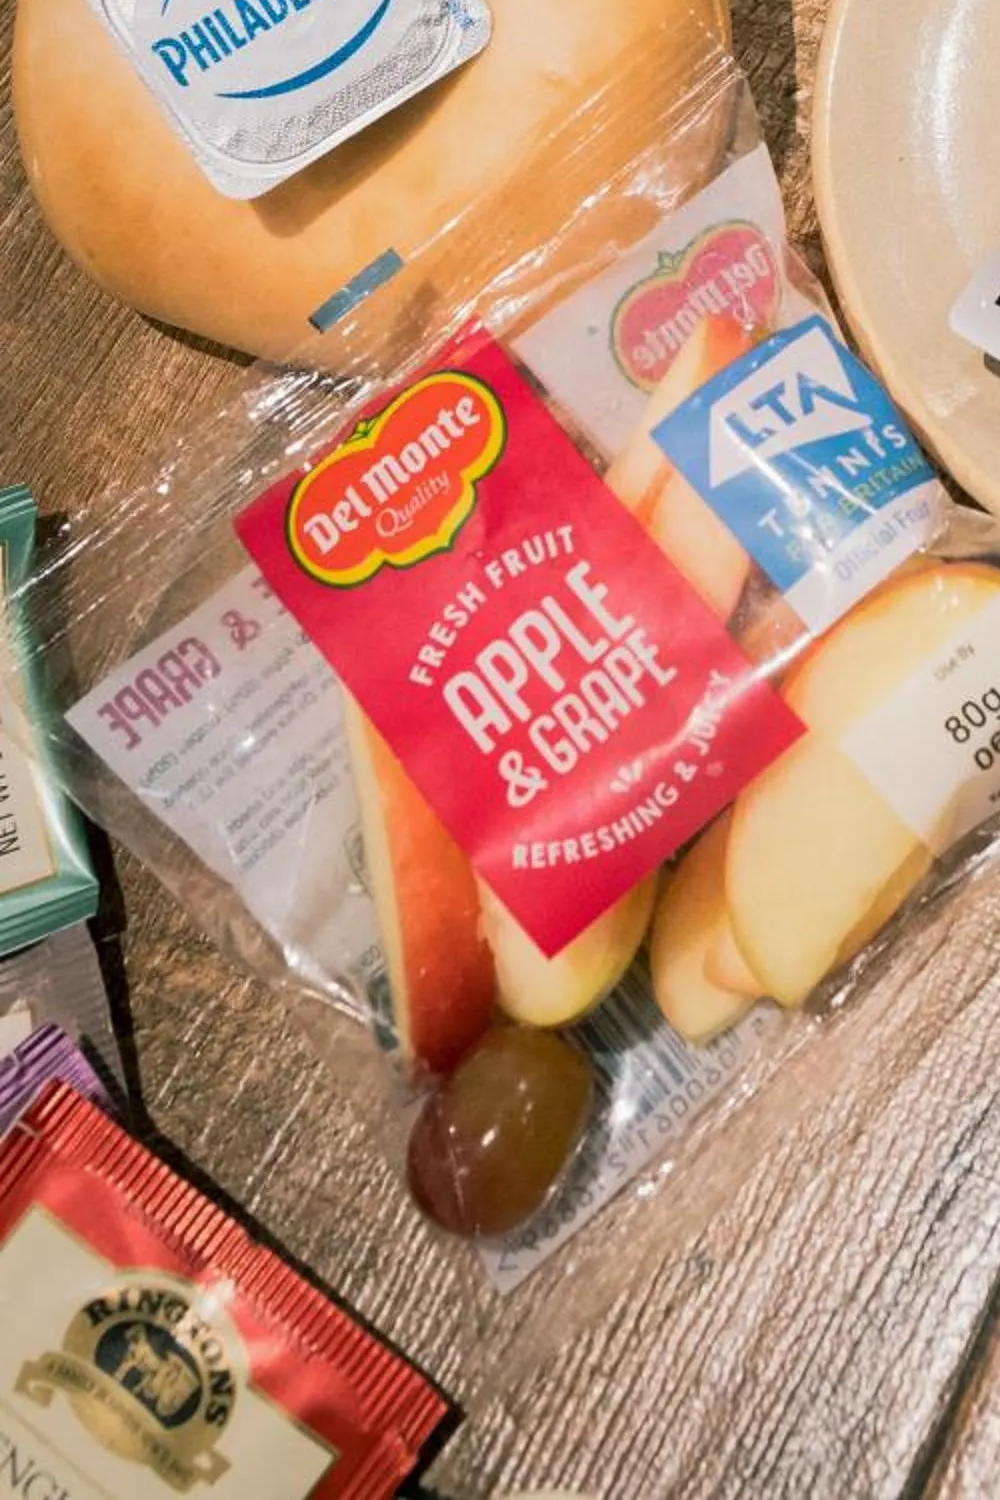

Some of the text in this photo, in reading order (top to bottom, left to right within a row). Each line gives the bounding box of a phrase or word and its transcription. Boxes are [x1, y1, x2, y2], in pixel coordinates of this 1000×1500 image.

[304, 396, 481, 556] Del Monte
[724, 372, 858, 449] LTA
[375, 469, 452, 538] Quality
[836, 444, 926, 522] BRITAIN
[408, 525, 576, 687] FRESH FRUIT
[443, 560, 635, 755] APPLE
[498, 628, 677, 808] & GRAPE
[512, 781, 679, 871] REFRESHING
[675, 760, 698, 783] &
